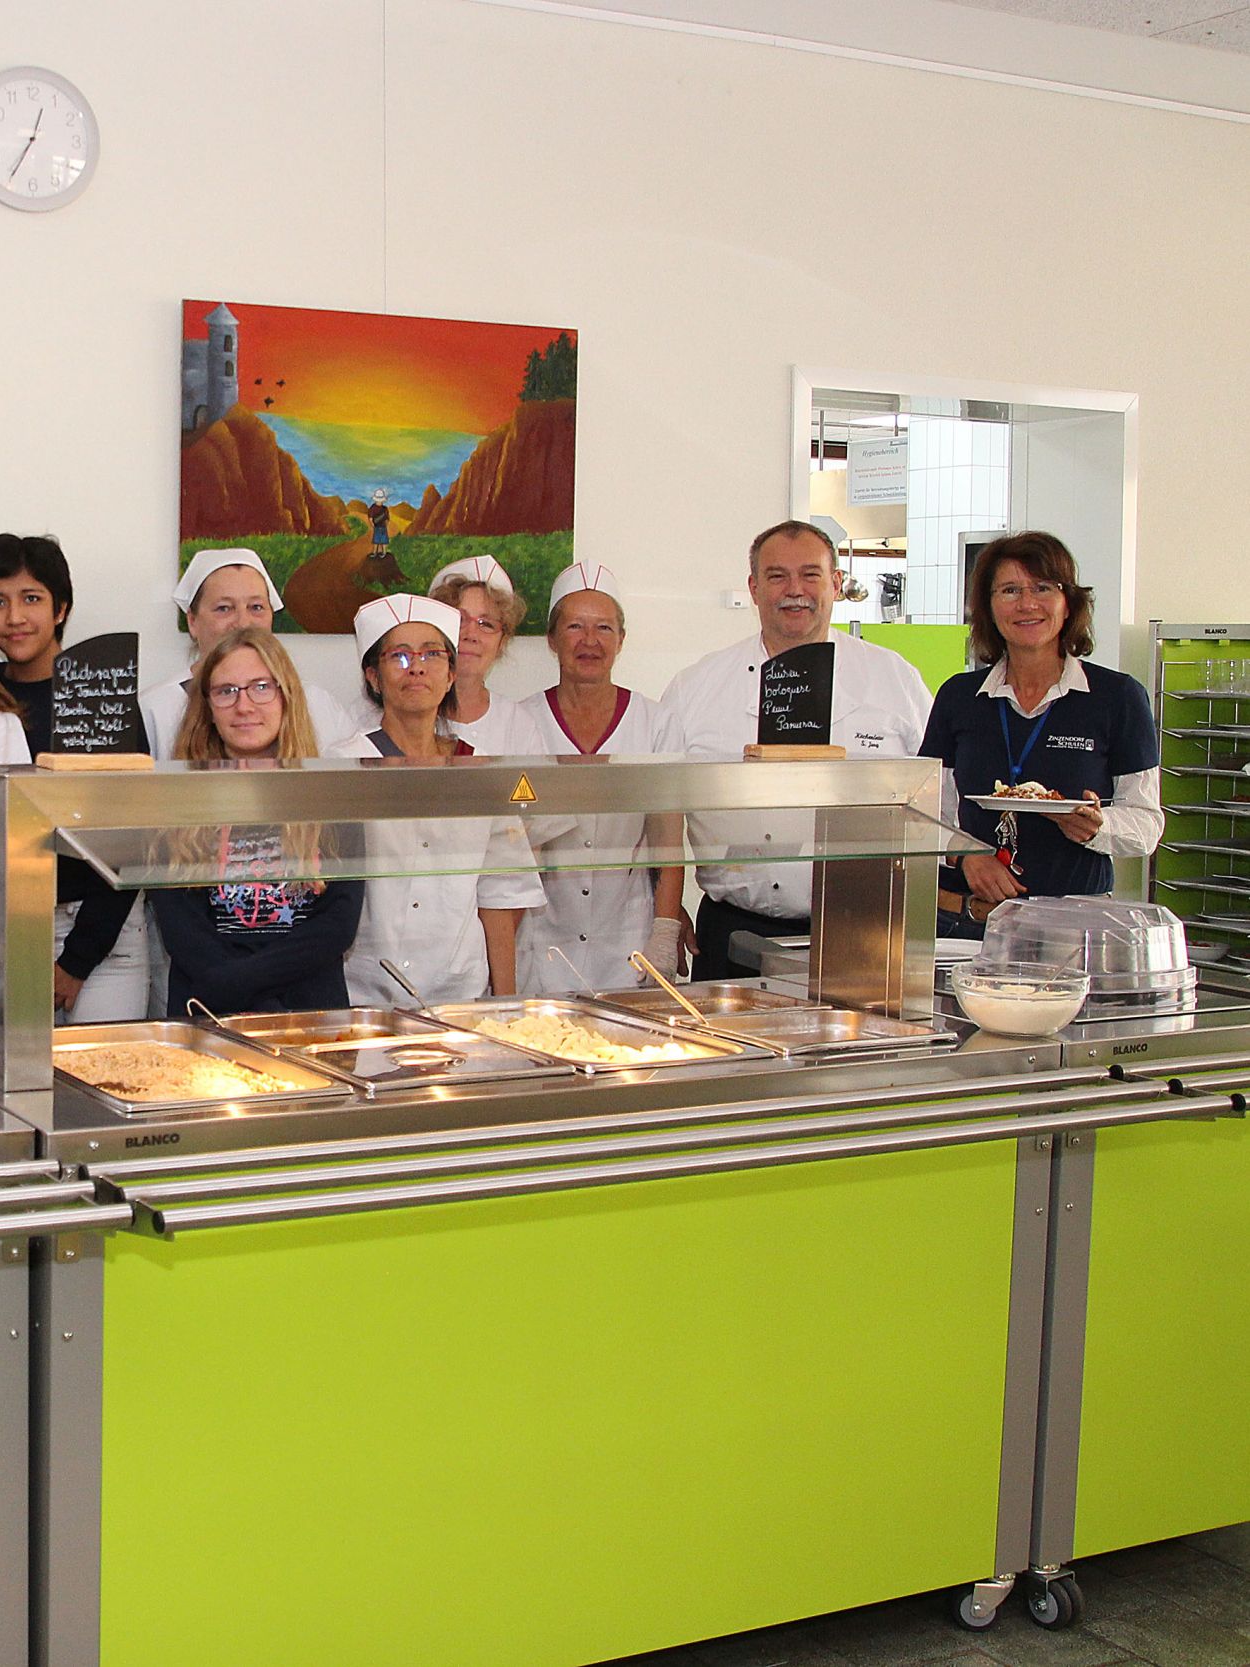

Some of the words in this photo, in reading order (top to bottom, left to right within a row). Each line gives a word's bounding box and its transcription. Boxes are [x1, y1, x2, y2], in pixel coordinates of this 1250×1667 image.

[6, 91, 17, 105] 11
[27, 87, 40, 101] 12
[66, 111, 76, 127] 2
[71, 134, 82, 149] 3
[28, 177, 38, 192] 6
[1112, 1043, 1148, 1056] BLANCO
[125, 1132, 181, 1149] BLANCO
